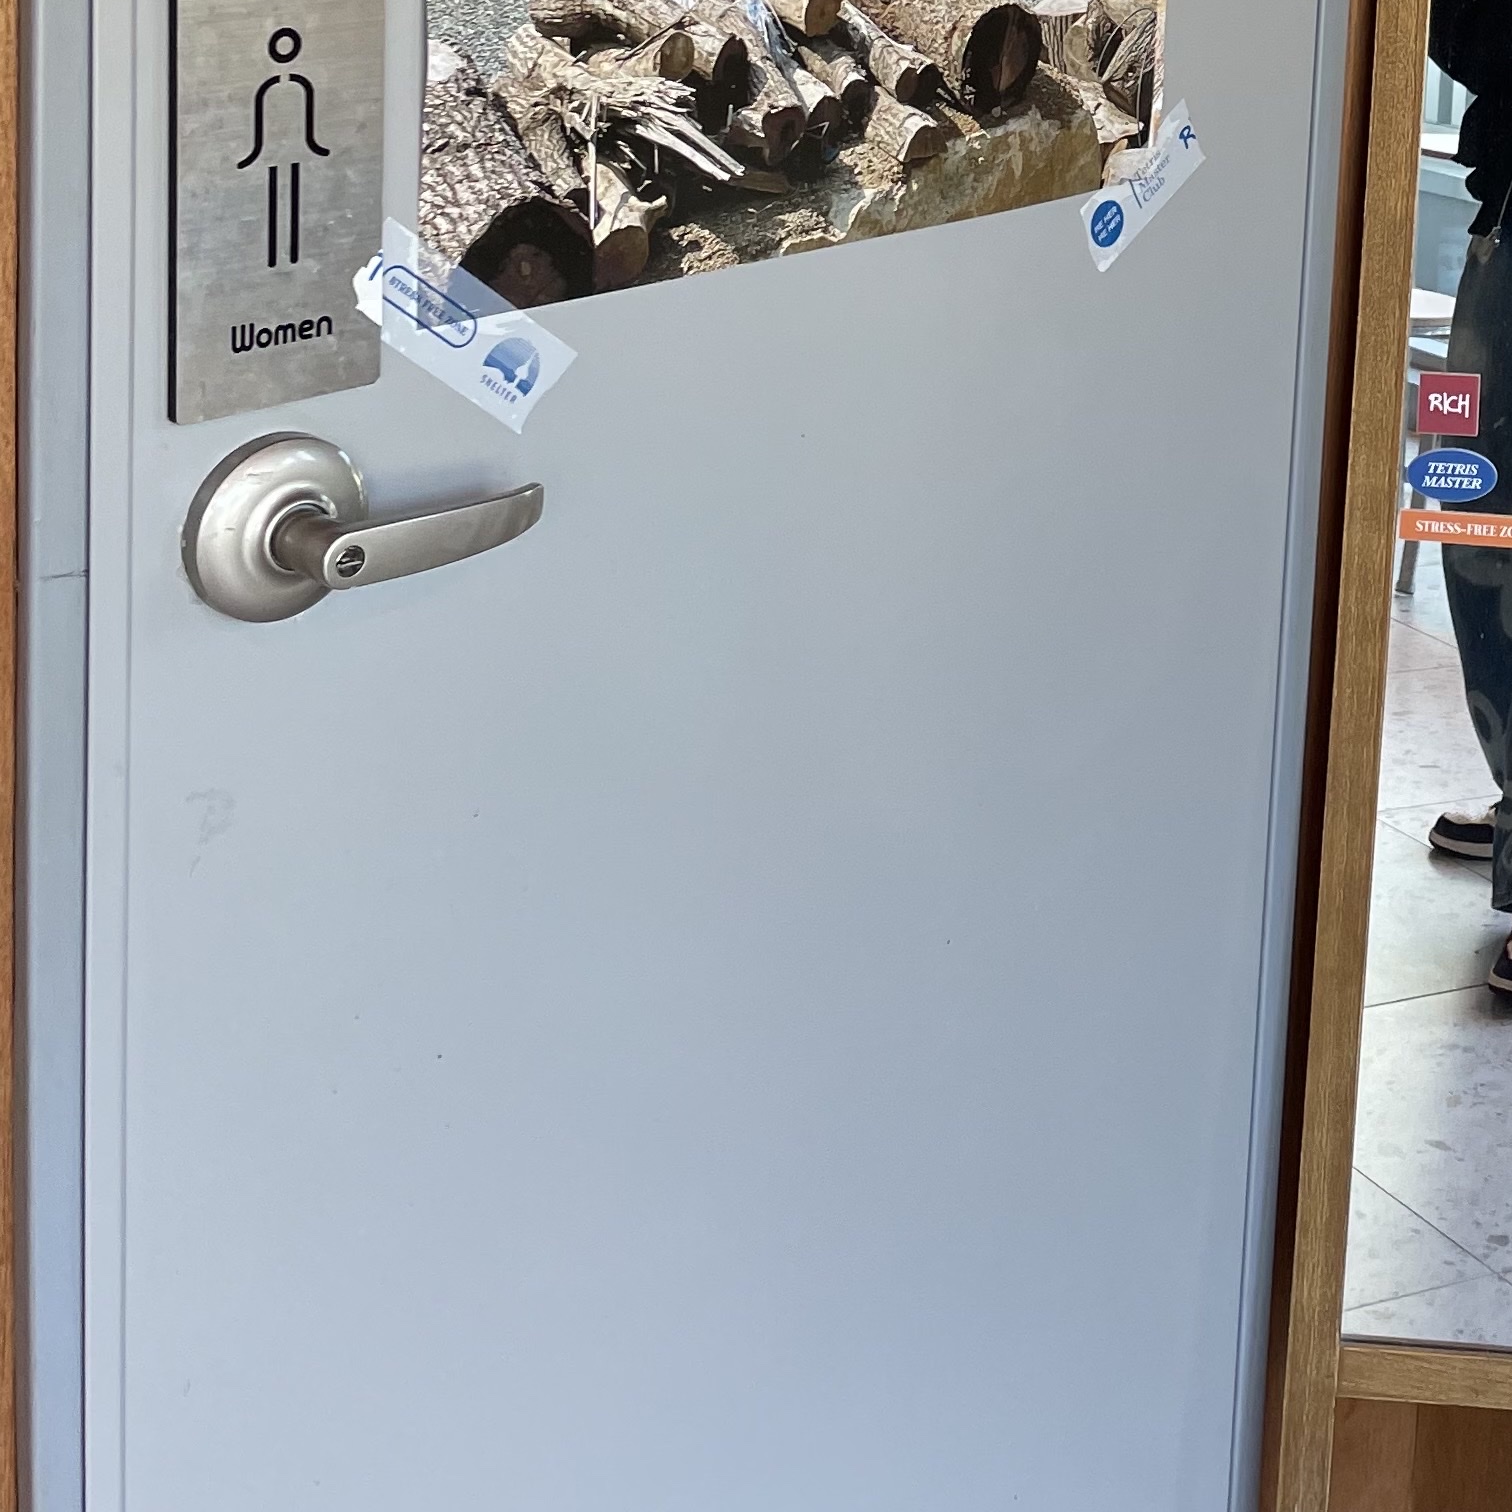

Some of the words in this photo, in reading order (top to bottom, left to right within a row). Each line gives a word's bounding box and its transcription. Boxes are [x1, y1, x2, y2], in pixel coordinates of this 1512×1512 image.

[1142, 176, 1165, 203] Club
[231, 315, 333, 354] Women
[480, 374, 518, 404] SHELTER
[1428, 391, 1470, 419] RICH
[1427, 461, 1479, 476] TETRIS
[1421, 476, 1483, 490] MASTER
[1415, 519, 1497, 537] STRESS-FREE
